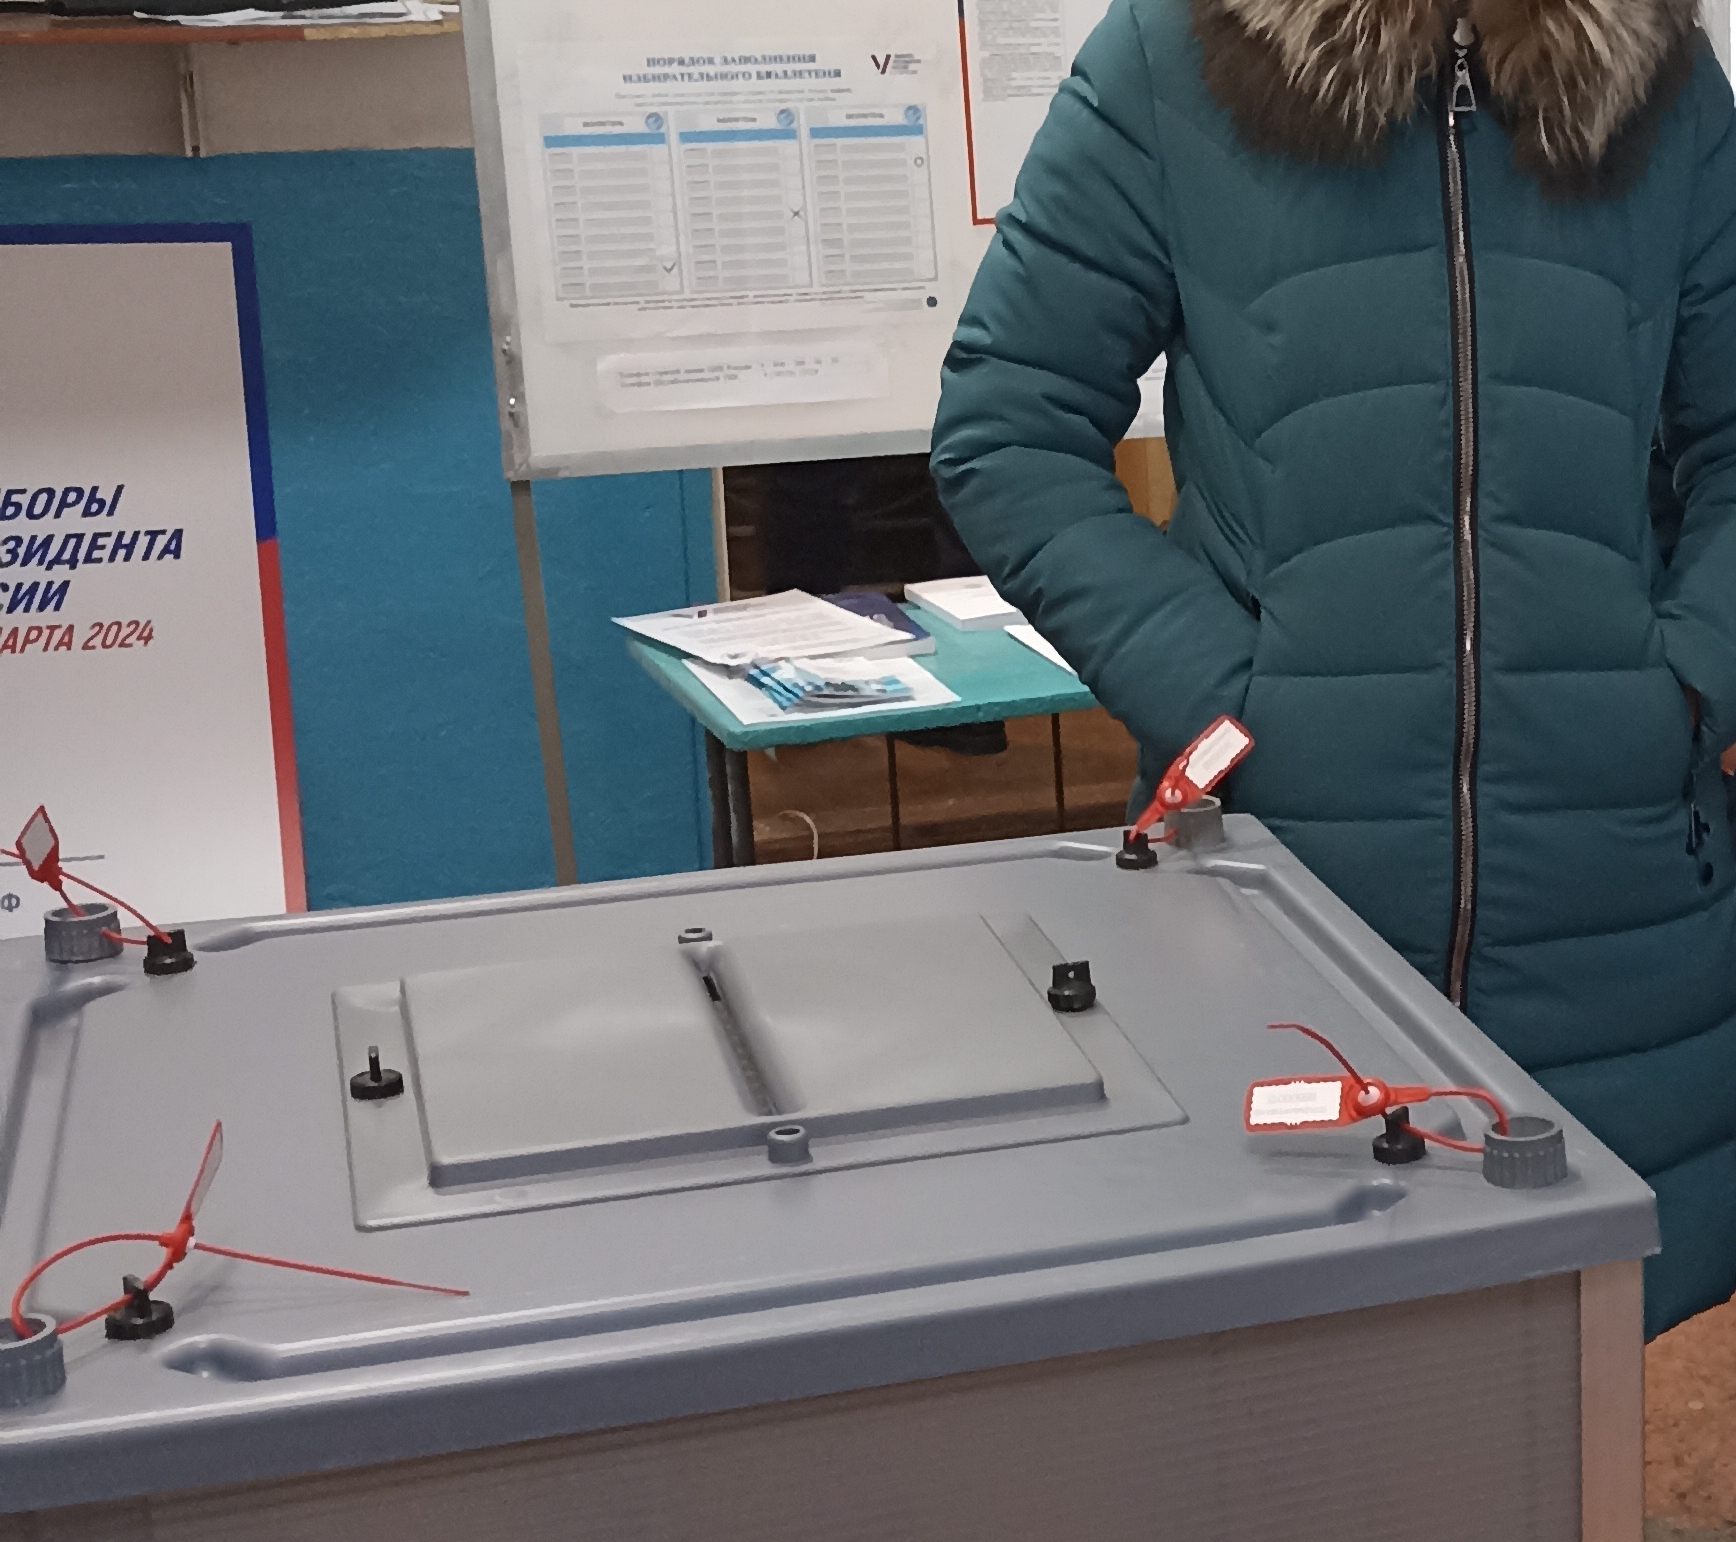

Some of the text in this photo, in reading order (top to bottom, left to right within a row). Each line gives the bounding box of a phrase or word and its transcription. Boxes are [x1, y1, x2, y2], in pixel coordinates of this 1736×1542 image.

[0, 484, 125, 522] БОРЫ
[0, 619, 155, 655] АРТА 2024
